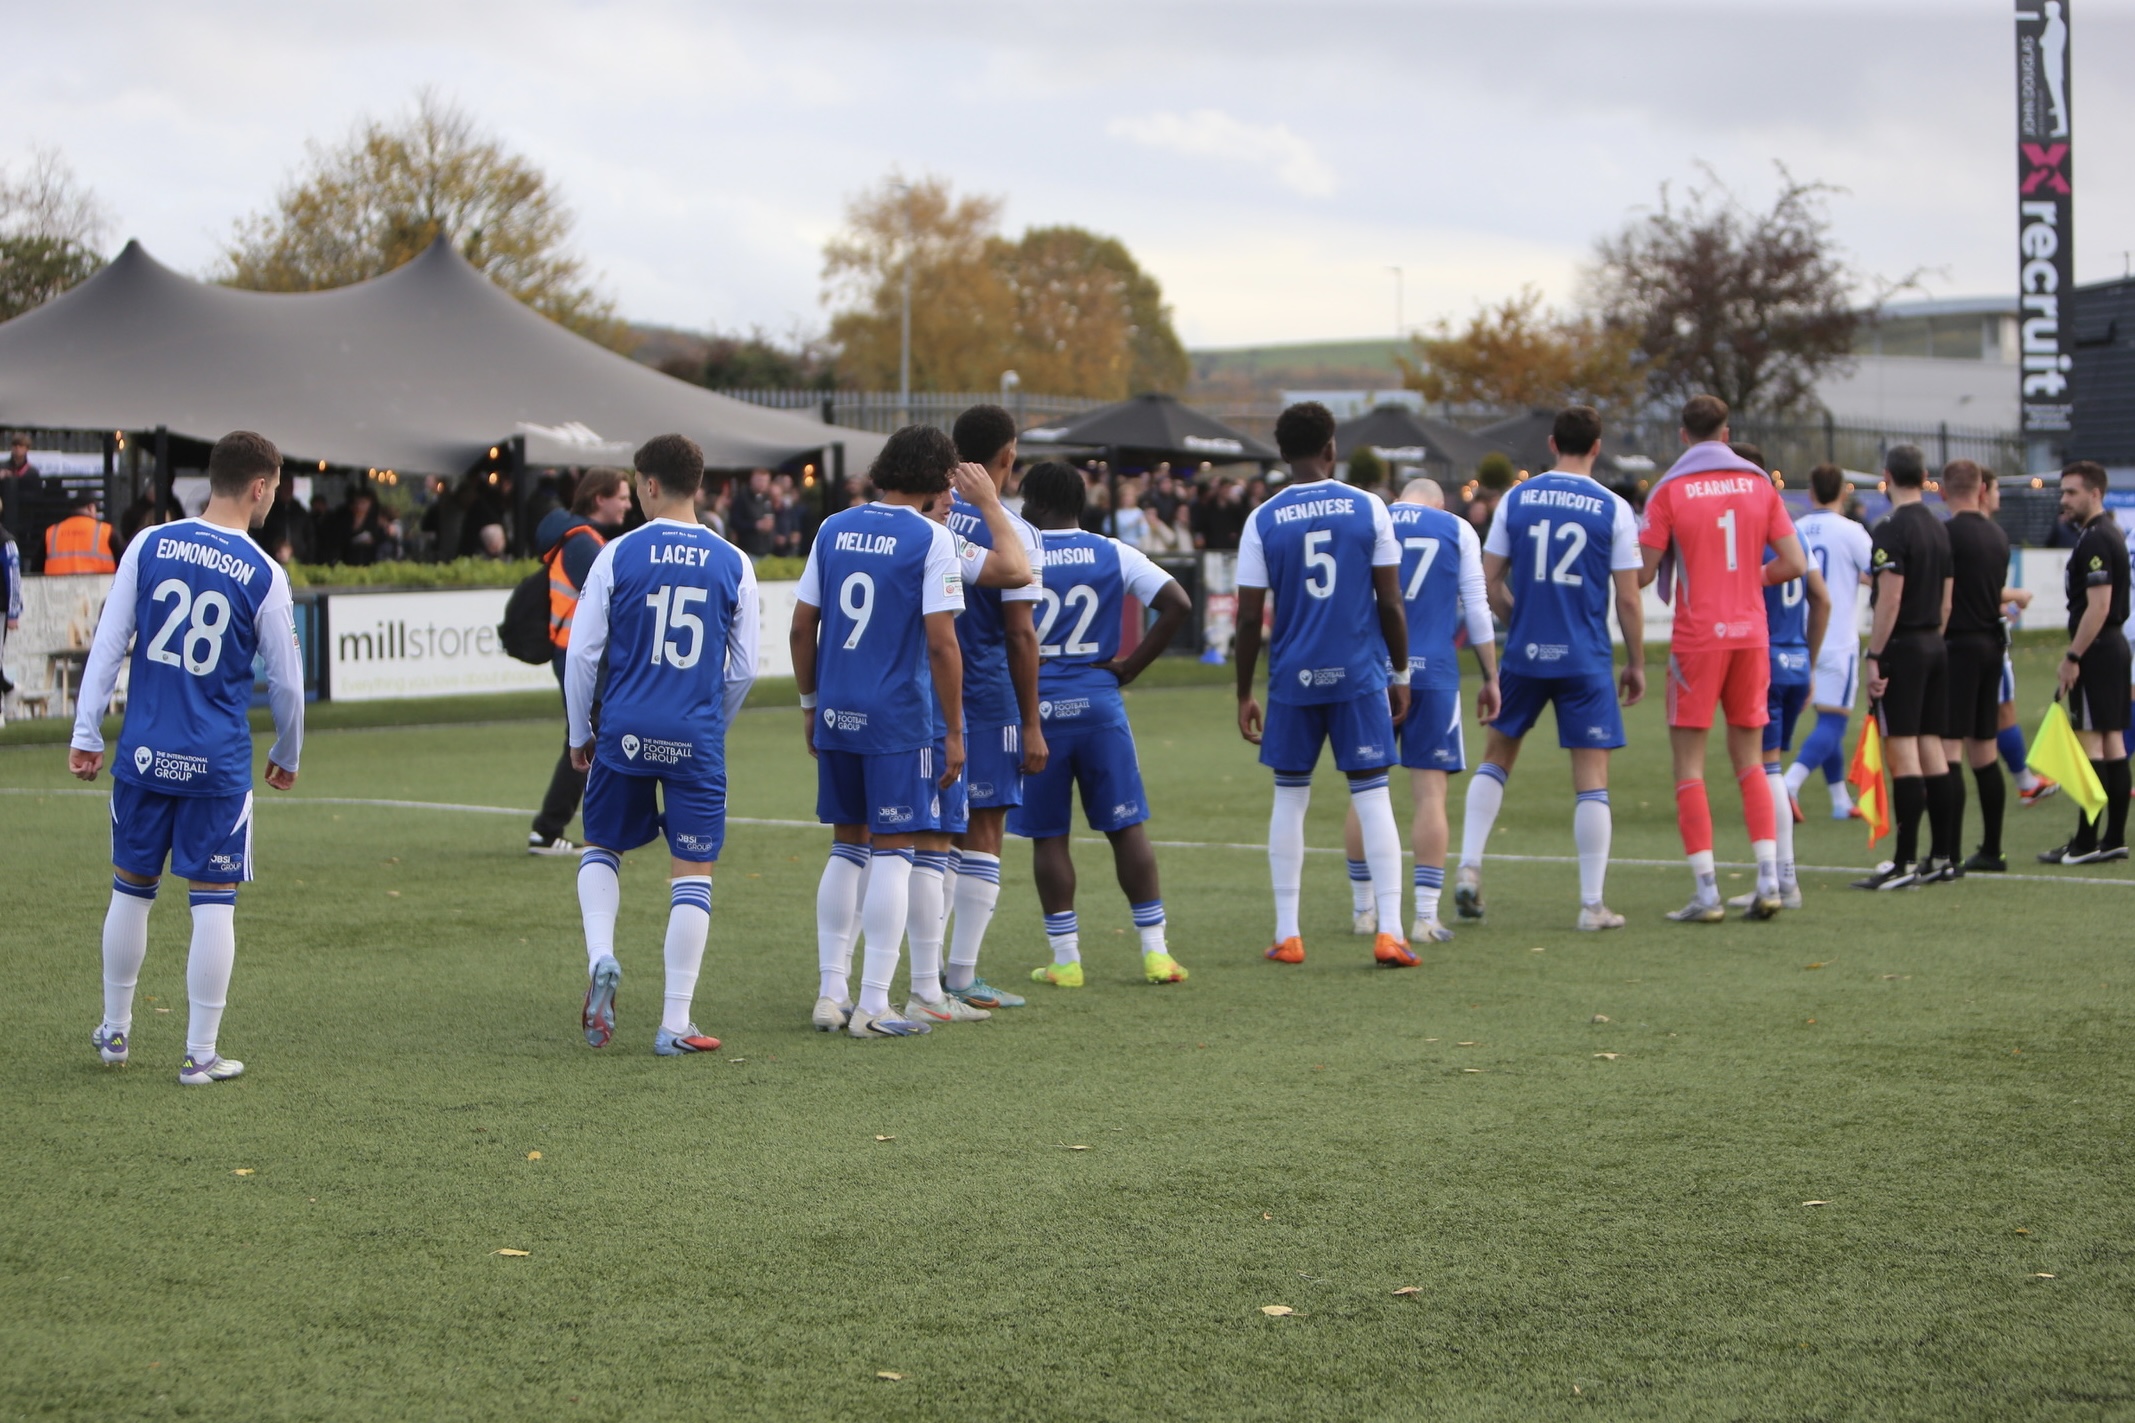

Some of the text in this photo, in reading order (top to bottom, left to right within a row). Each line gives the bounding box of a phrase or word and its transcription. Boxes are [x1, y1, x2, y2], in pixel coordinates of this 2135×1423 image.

[2021, 200, 2073, 397] recruit
[1685, 478, 1754, 498] DEARNLEY
[1275, 499, 1355, 524] MENAYESE
[1520, 489, 1603, 514] HEATHCOTE
[835, 532, 897, 555] MELLOR
[1717, 508, 1738, 572] 1
[156, 538, 257, 586] EDMONDSON
[650, 544, 710, 567] LACEY
[1304, 529, 1337, 599] 5
[1528, 519, 1588, 587] 12
[1404, 537, 1440, 600] 7
[839, 571, 875, 650] 9
[1033, 584, 1099, 656] 22
[146, 578, 231, 677] 28
[646, 585, 708, 669] 15
[338, 618, 507, 663] millstore
[837, 715, 868, 726] FOOTBALL
[837, 722, 860, 731] GROUP
[643, 744, 692, 758] FOOTBALL
[653, 739, 693, 748] INTERNATIONAL
[155, 758, 208, 774] FOOTBALL
[166, 752, 208, 763] INTERNATIONAL
[643, 753, 679, 765] GROUP
[154, 768, 192, 782] GROUP
[687, 842, 712, 851] GROUP
[210, 855, 230, 864] JBSI
[221, 863, 242, 872] GROUP
